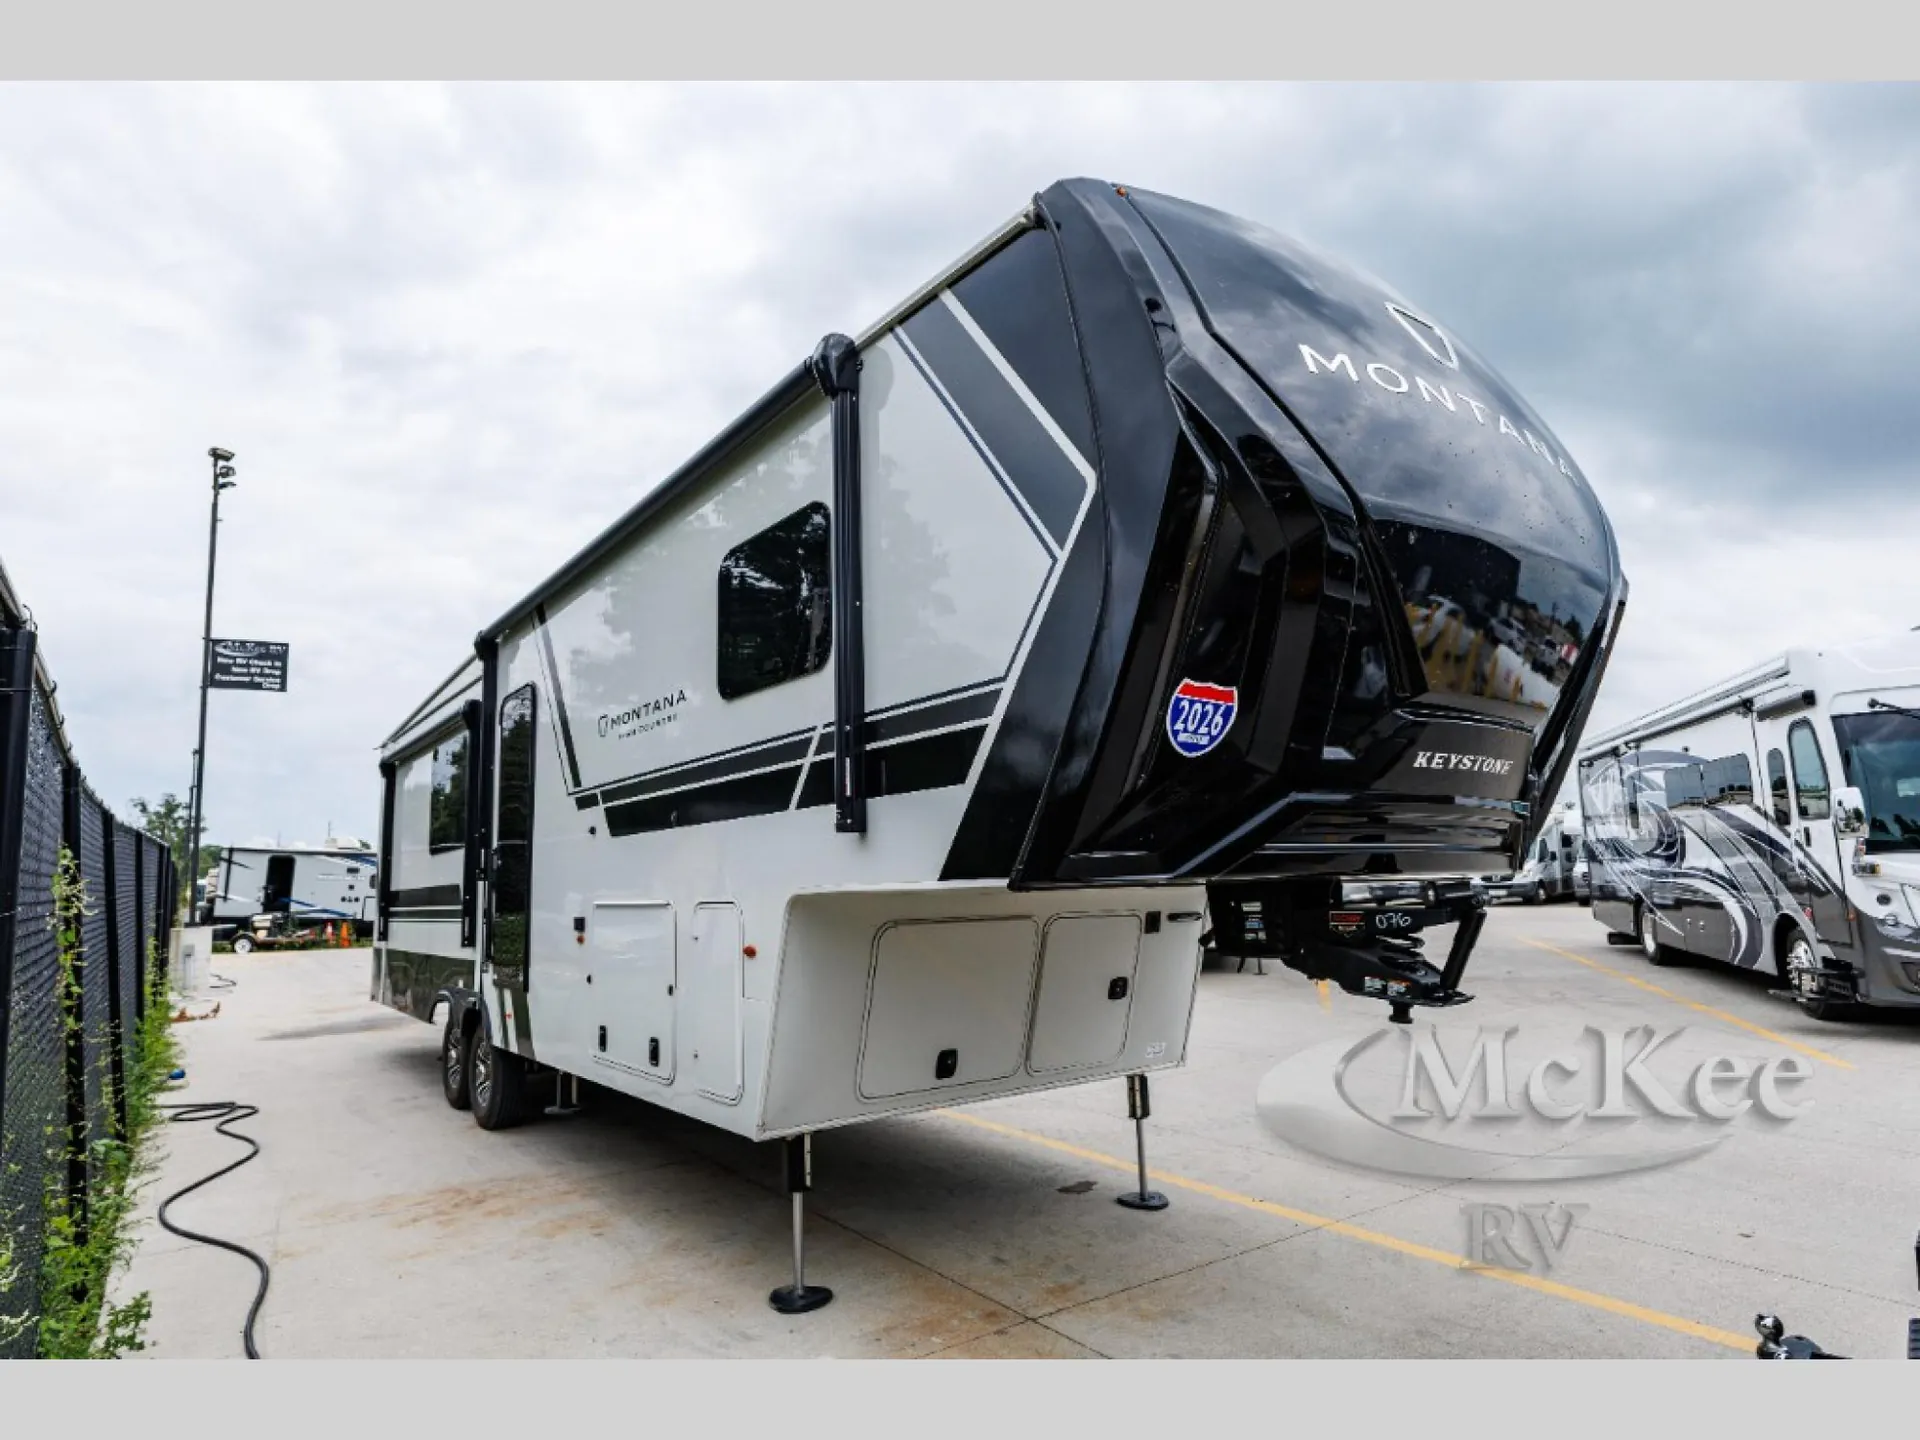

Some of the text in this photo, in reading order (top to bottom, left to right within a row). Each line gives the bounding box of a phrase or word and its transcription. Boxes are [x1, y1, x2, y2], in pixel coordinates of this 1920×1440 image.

[1298, 342, 1581, 487] MONTANA
[610, 689, 687, 730] MONTANA
[1173, 698, 1227, 736] 2026
[1412, 751, 1514, 775] KEYSTONE
